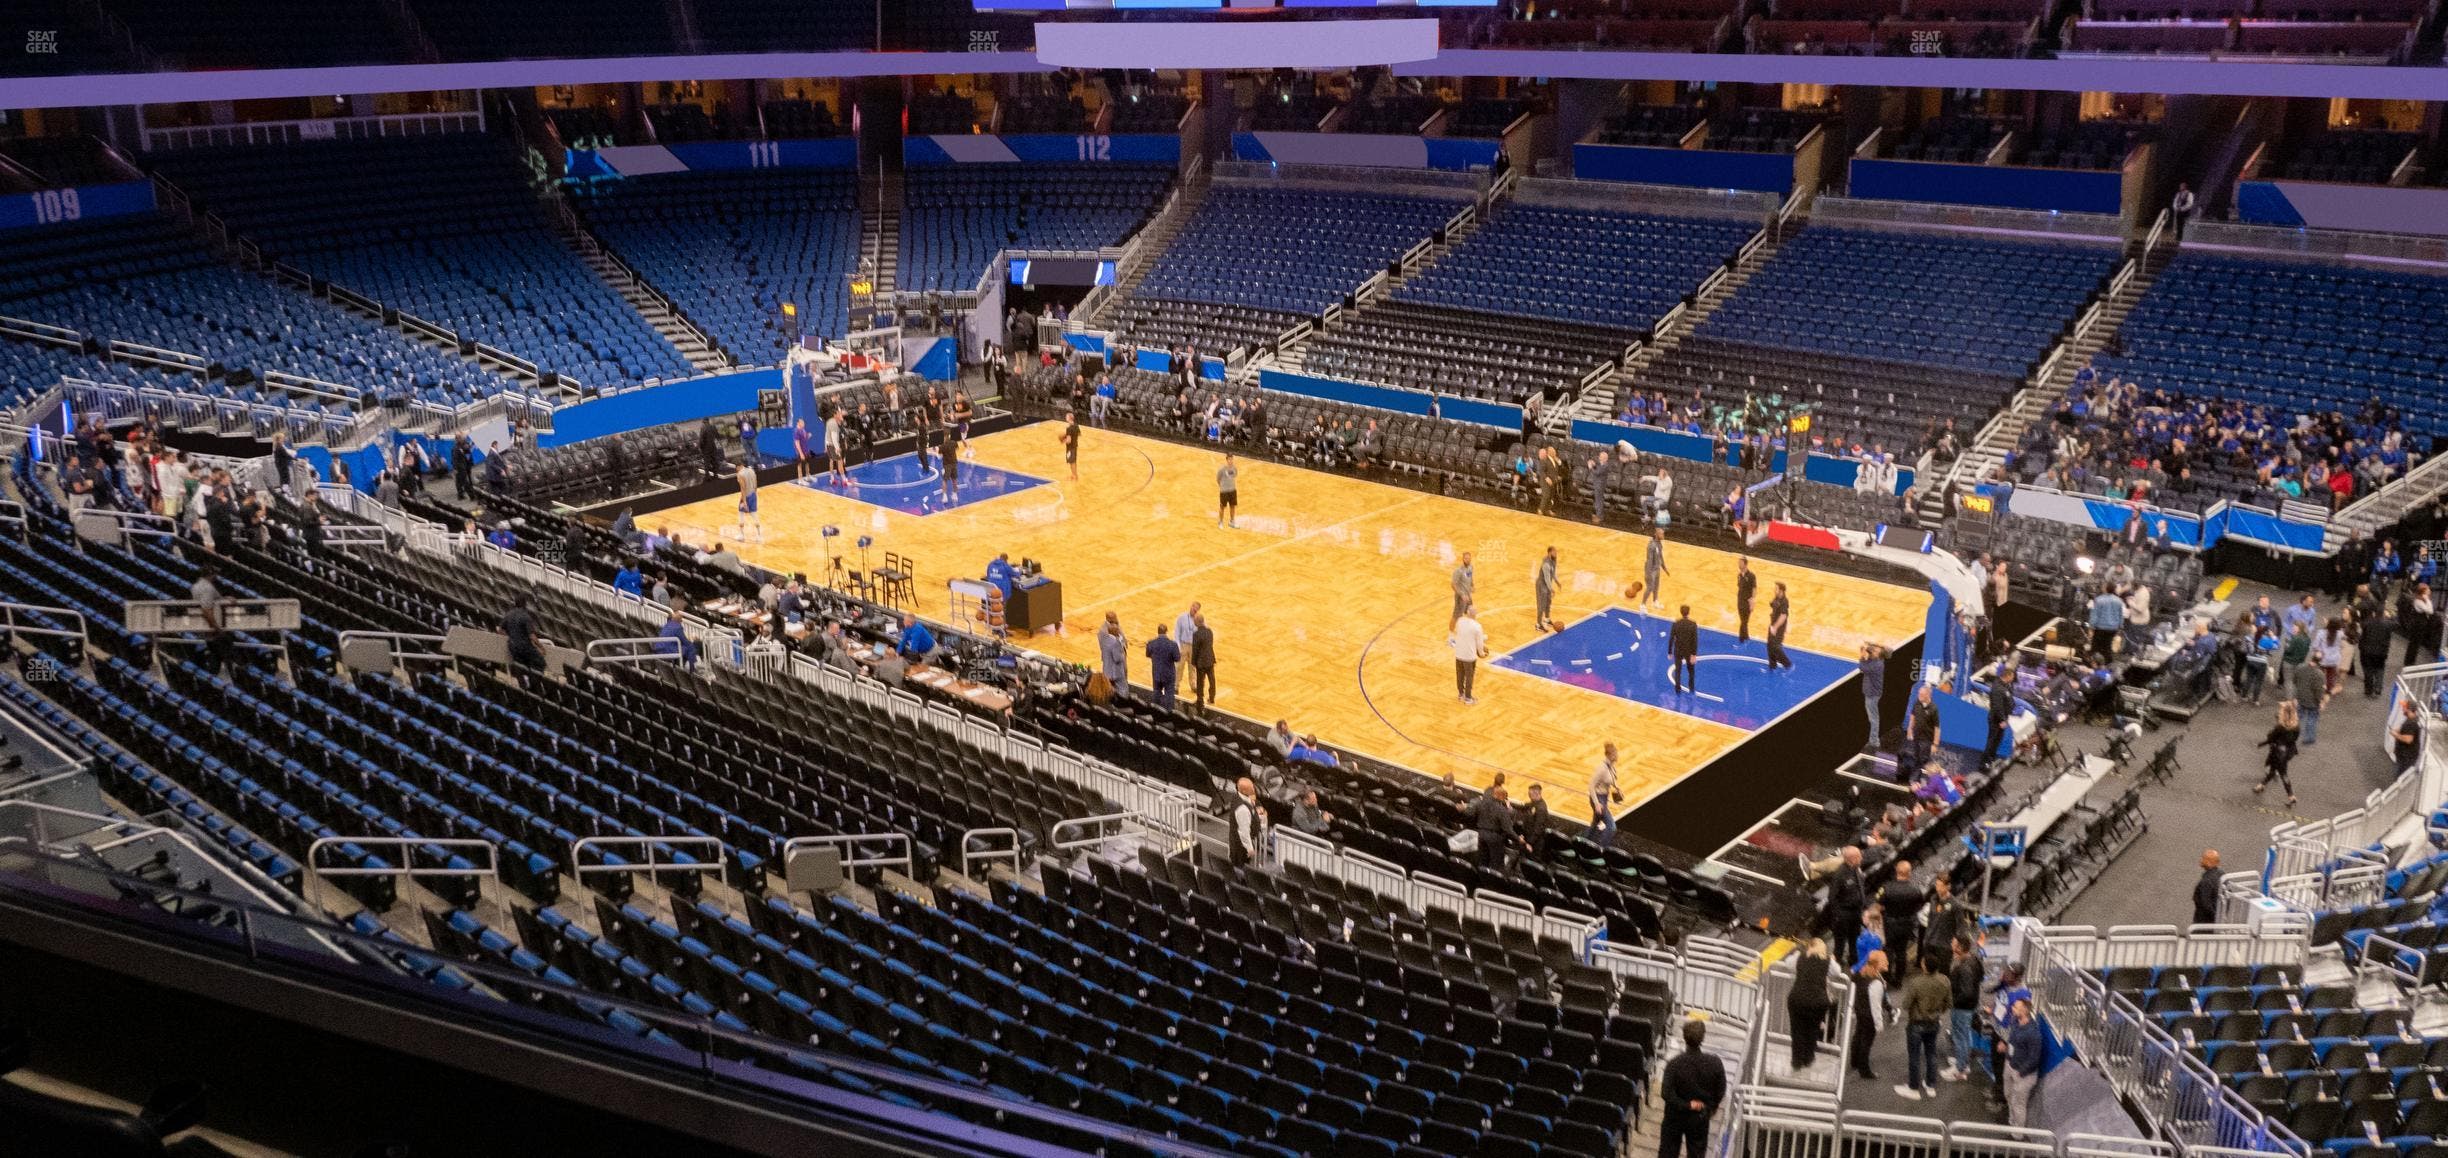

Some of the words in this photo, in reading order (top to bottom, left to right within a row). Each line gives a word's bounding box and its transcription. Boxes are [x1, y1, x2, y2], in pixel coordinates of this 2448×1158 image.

[748, 141, 780, 168] 111
[1076, 135, 1111, 161] 112
[32, 187, 80, 224] 109
